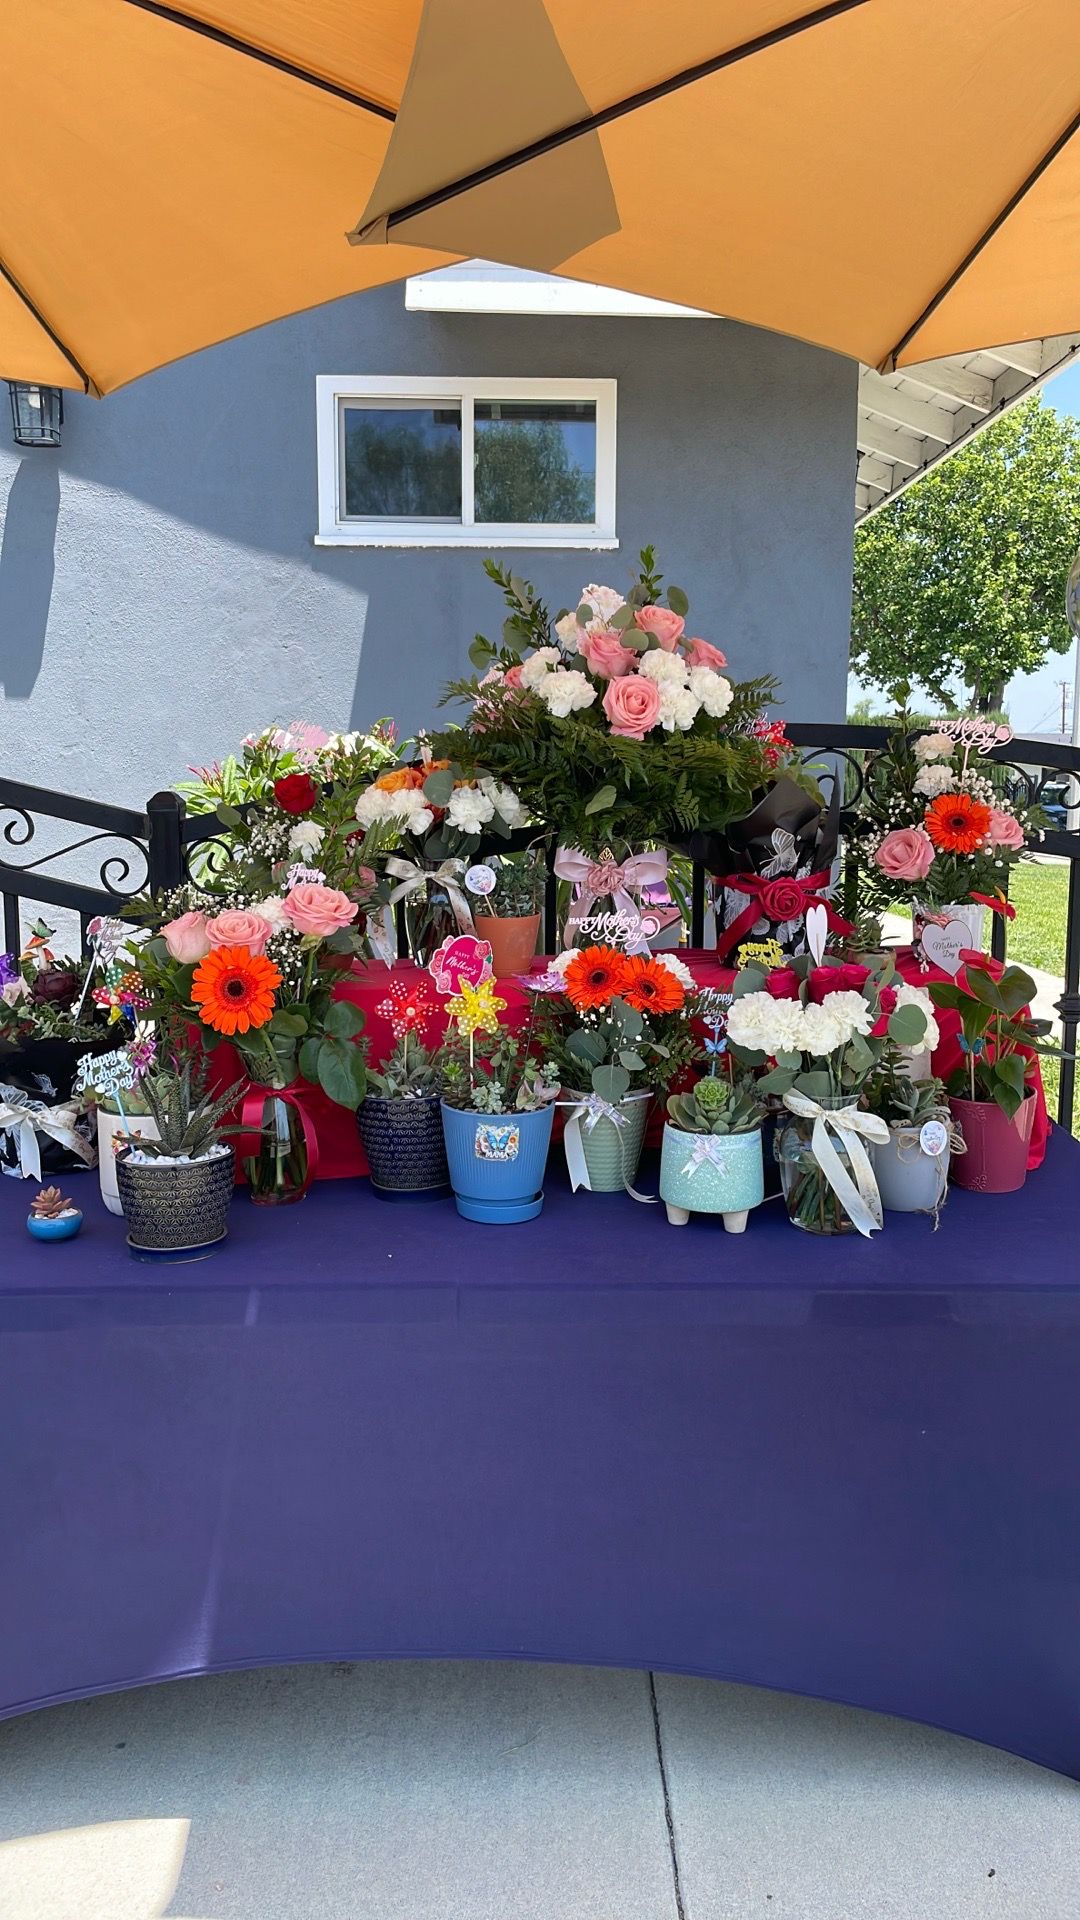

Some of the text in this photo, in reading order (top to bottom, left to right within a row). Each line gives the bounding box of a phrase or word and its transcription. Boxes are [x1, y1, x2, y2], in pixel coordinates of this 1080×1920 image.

[960, 731, 1008, 755] Day
[604, 925, 654, 950] Day
[445, 956, 480, 976] Mother's
[77, 1051, 117, 1076] Happy
[103, 1078, 137, 1097] Day
[485, 1151, 509, 1159] MAMA
